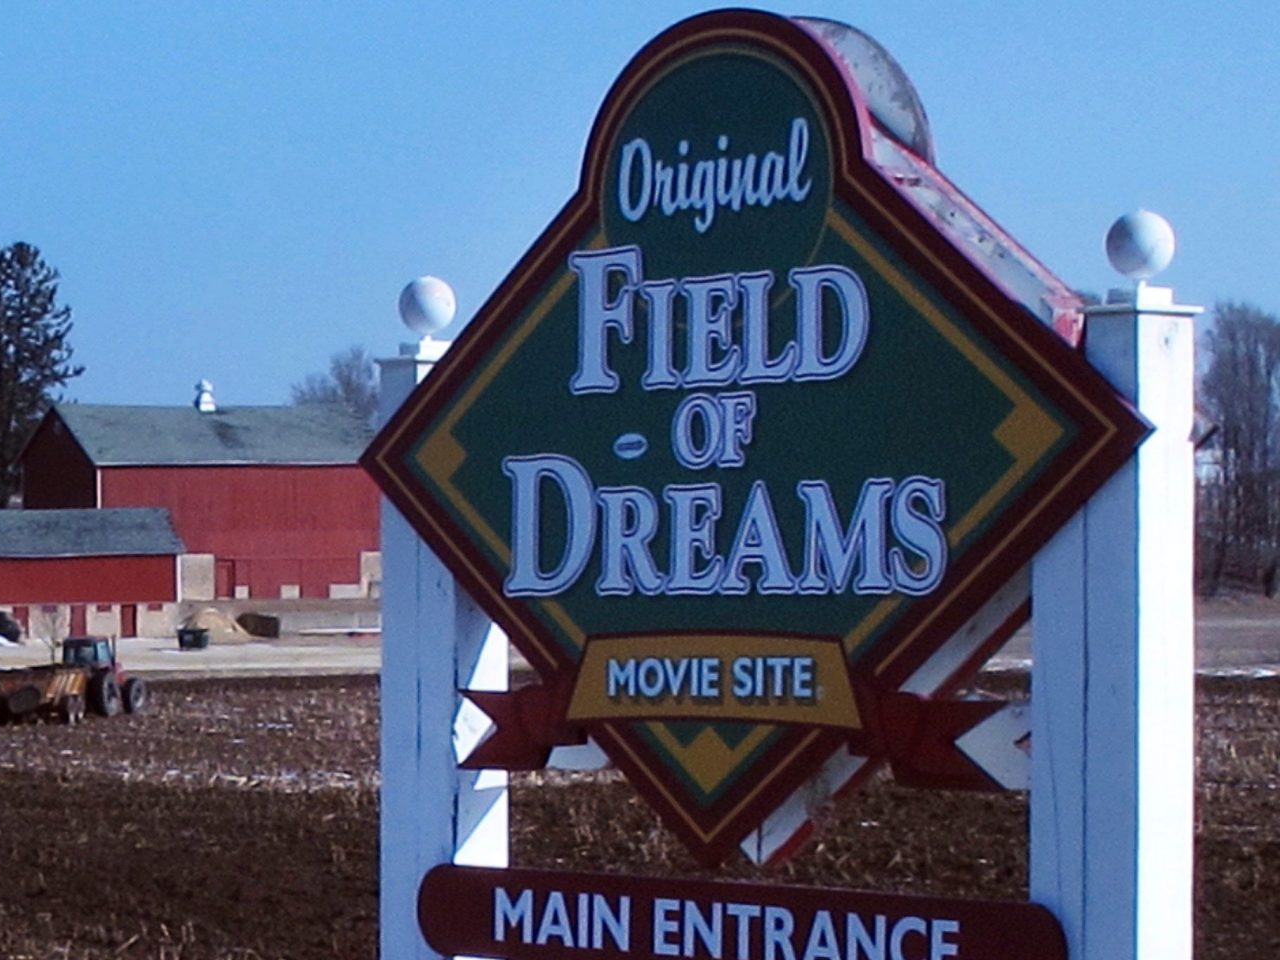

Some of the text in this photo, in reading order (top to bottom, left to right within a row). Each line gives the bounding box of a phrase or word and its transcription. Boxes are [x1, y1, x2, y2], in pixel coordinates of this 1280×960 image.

[618, 118, 812, 232] Original
[569, 246, 870, 394] FIELD
[673, 391, 756, 470] OF
[502, 454, 947, 597] DREAMS
[606, 656, 814, 699] MOVIE SITE
[493, 887, 631, 953] MAIN
